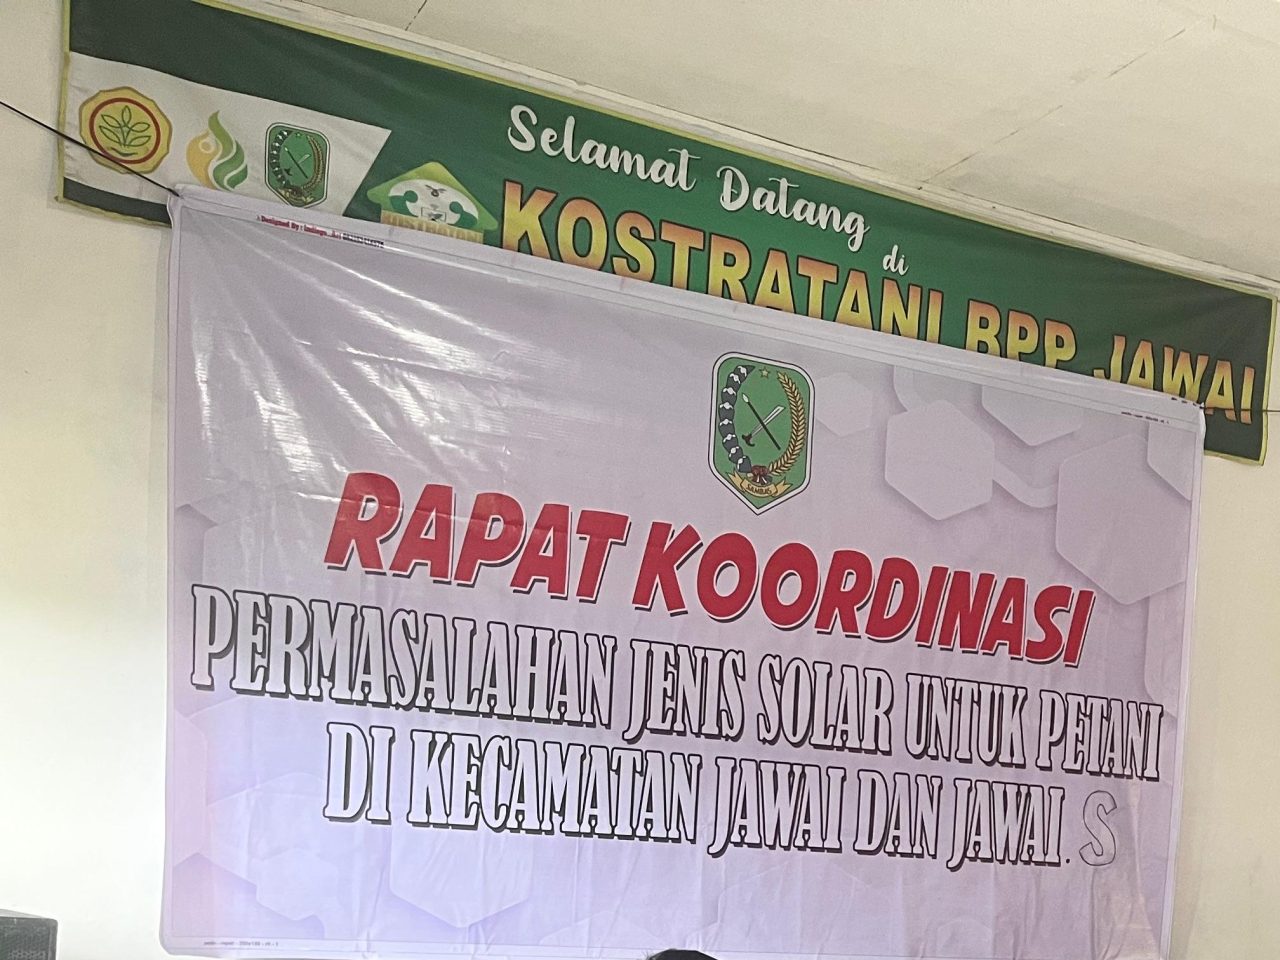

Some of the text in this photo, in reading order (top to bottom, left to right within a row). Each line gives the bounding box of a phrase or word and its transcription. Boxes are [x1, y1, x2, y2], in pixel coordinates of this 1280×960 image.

[507, 104, 909, 275] Selamat Datang di
[502, 179, 1256, 425] KOSTRATANI BPP JAWAI
[323, 471, 1096, 668] RAPAT KOORDINASI
[190, 584, 1164, 782] PERMASALAHAN JENIS SOLAR UNTUK PETANI
[322, 721, 396, 825] DI
[406, 729, 702, 845] KECAMATAN
[708, 756, 848, 858] JAWAI
[853, 768, 944, 860] DAN
[1078, 789, 1118, 867] S
